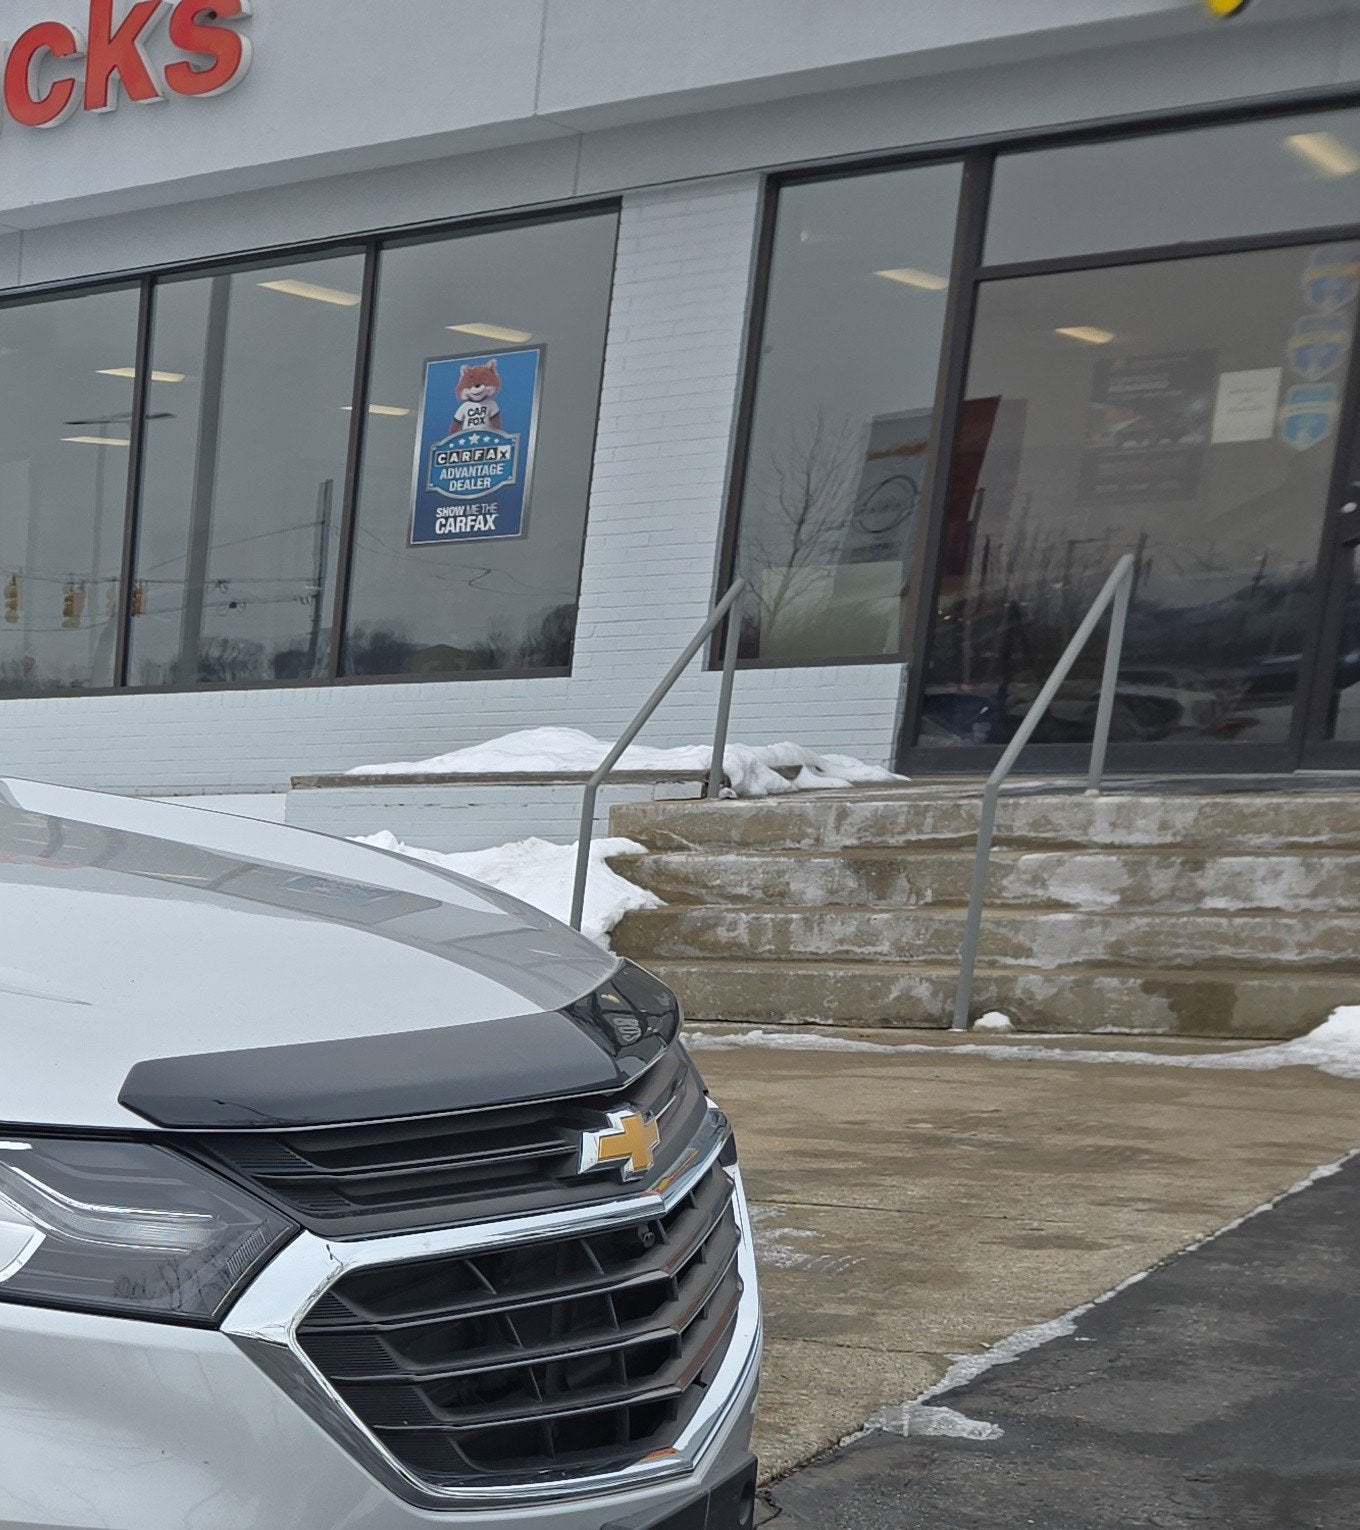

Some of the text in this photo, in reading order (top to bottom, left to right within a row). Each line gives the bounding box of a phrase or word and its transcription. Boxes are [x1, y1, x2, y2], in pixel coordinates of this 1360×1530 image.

[467, 406, 487, 417] CAR
[467, 417, 486, 428] FOX
[436, 446, 511, 465] CARFAX
[439, 463, 504, 480] ADVANTAGE
[449, 478, 491, 491] DEALER
[435, 505, 465, 518] SHOW
[435, 515, 496, 534] CARFAX
